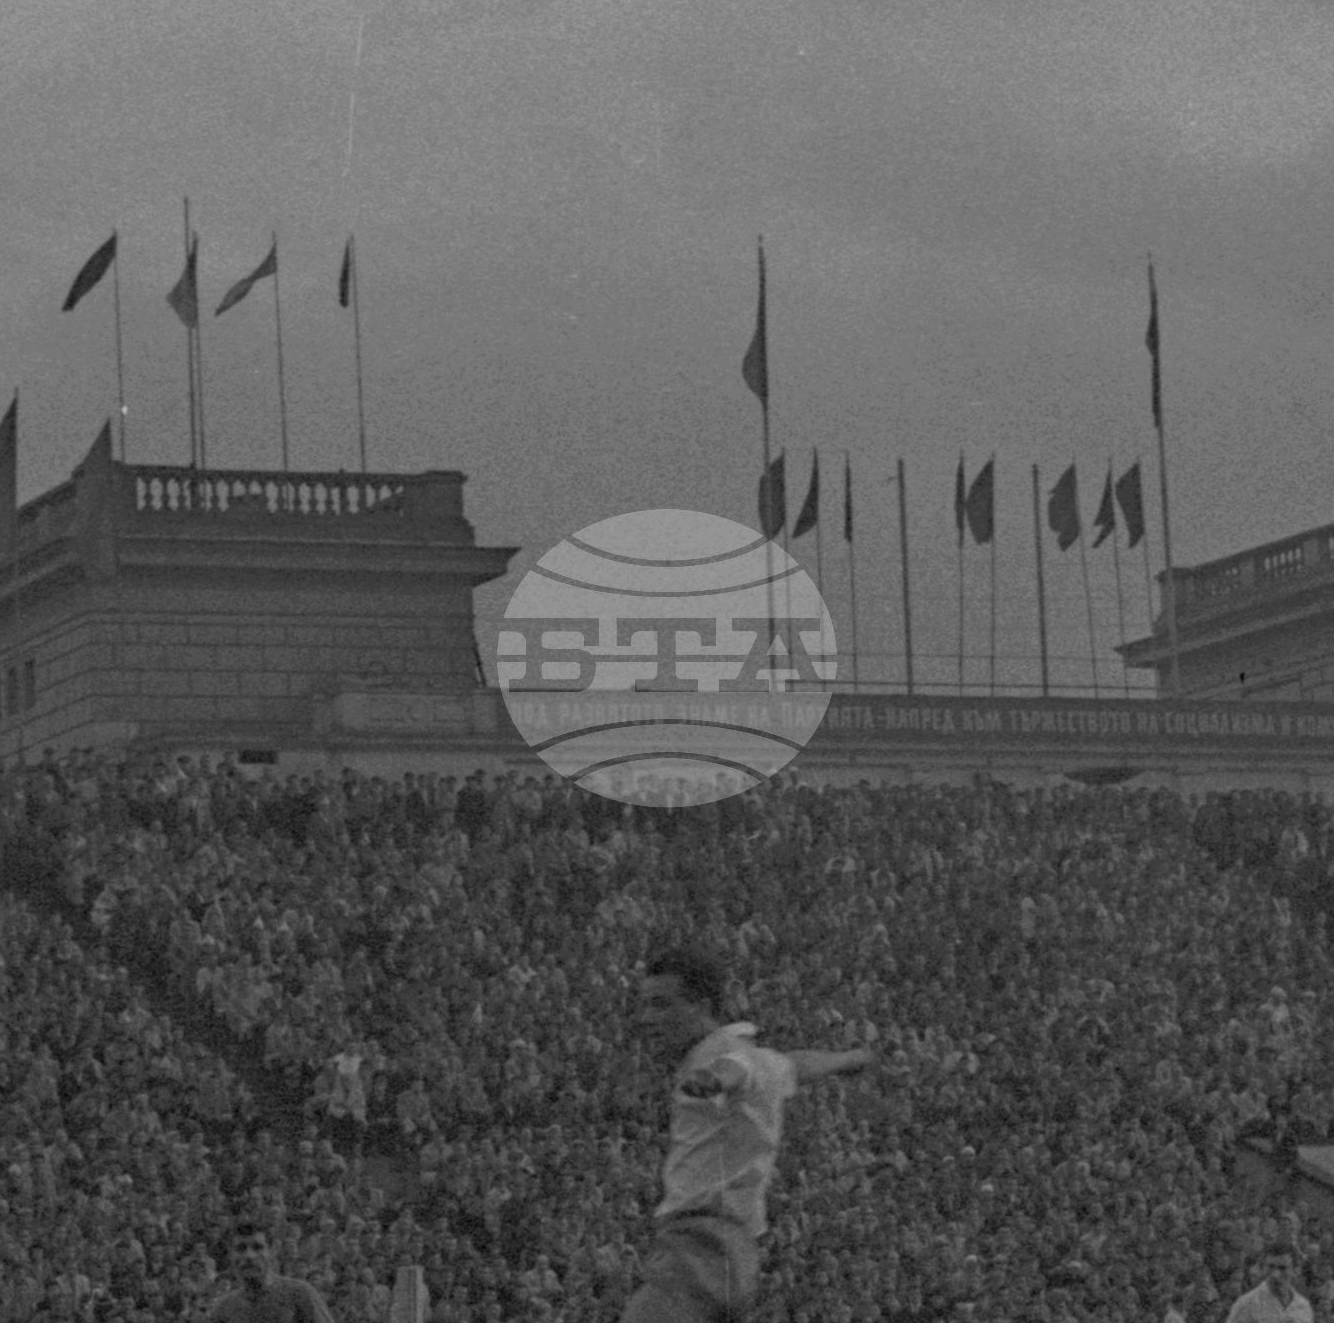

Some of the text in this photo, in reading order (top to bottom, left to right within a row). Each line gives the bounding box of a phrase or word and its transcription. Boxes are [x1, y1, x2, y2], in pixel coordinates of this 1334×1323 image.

[510, 703, 548, 726] ПОД
[748, 705, 770, 727] НА
[962, 709, 1002, 732] КЪМ
[1008, 710, 1130, 736] ТЪРЖЕСТВОТО
[1136, 712, 1159, 735] НА
[1165, 712, 1275, 737] СОЦИАЛИЗМА
